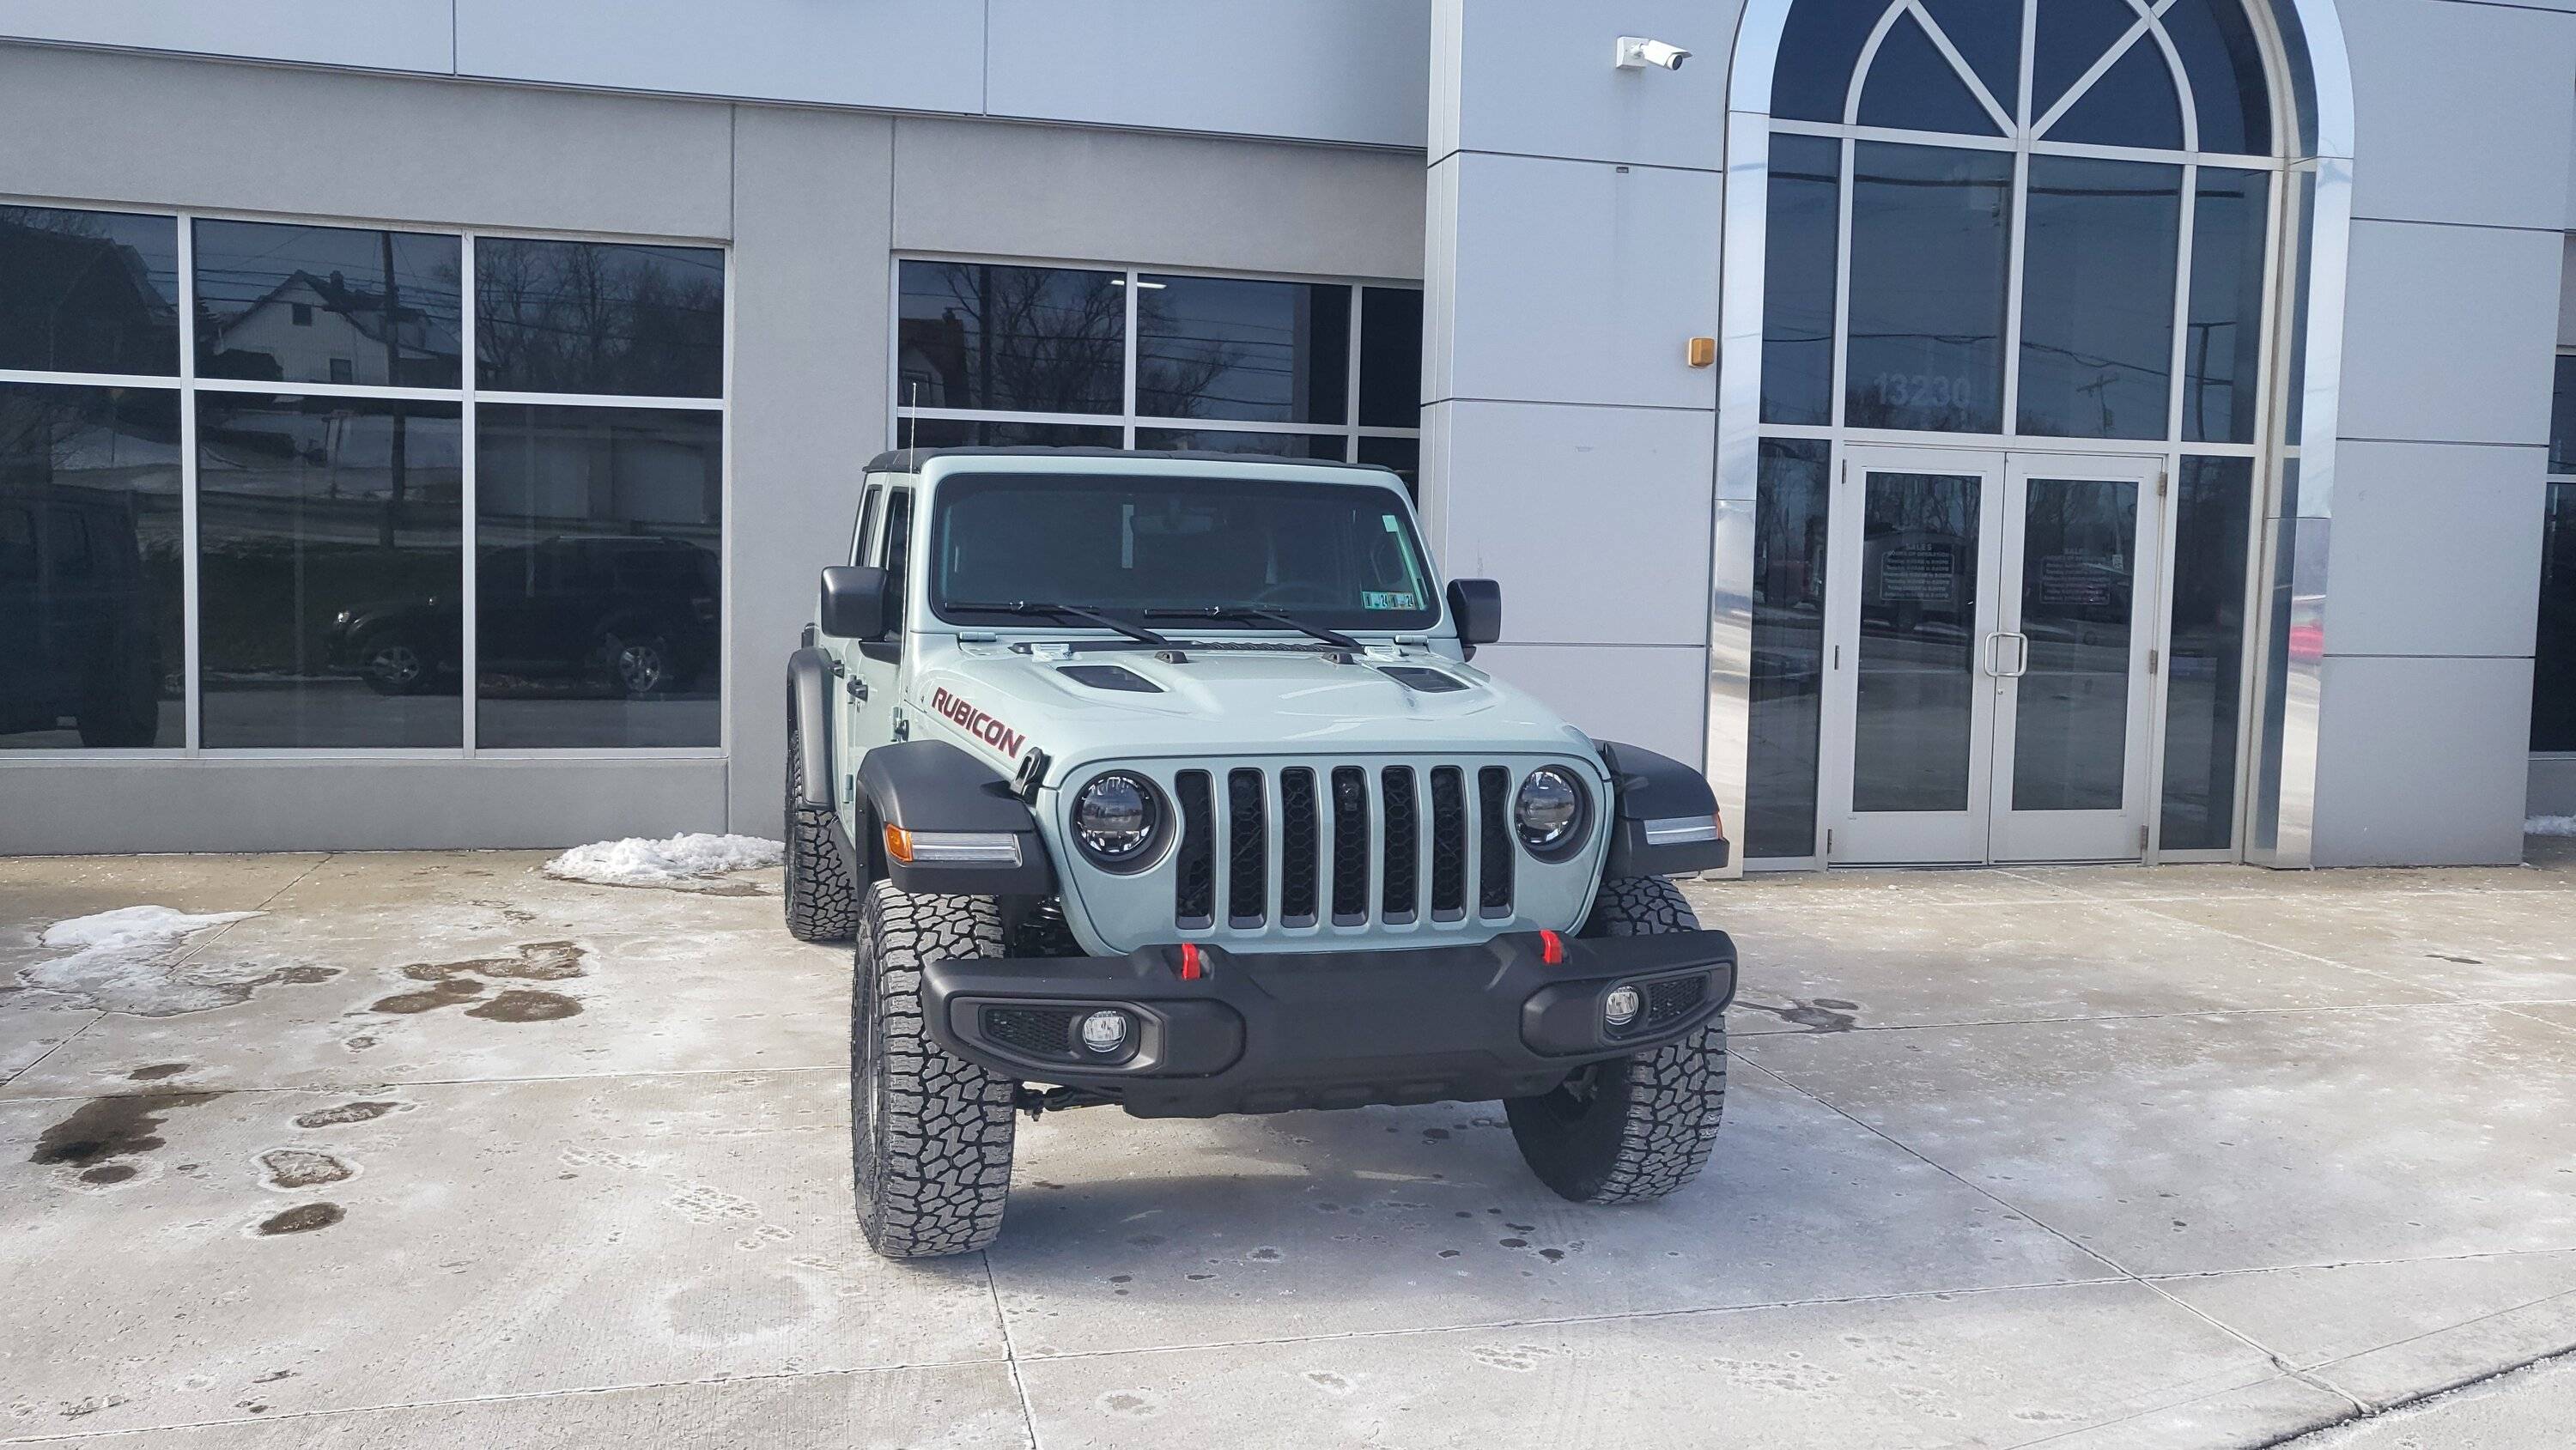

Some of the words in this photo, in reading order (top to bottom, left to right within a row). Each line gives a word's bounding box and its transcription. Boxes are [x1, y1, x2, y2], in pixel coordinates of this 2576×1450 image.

[1874, 372, 1971, 408] 13230
[1380, 594, 1389, 608] 24
[1406, 594, 1415, 608] 24
[932, 687, 1026, 759] RUBICON
